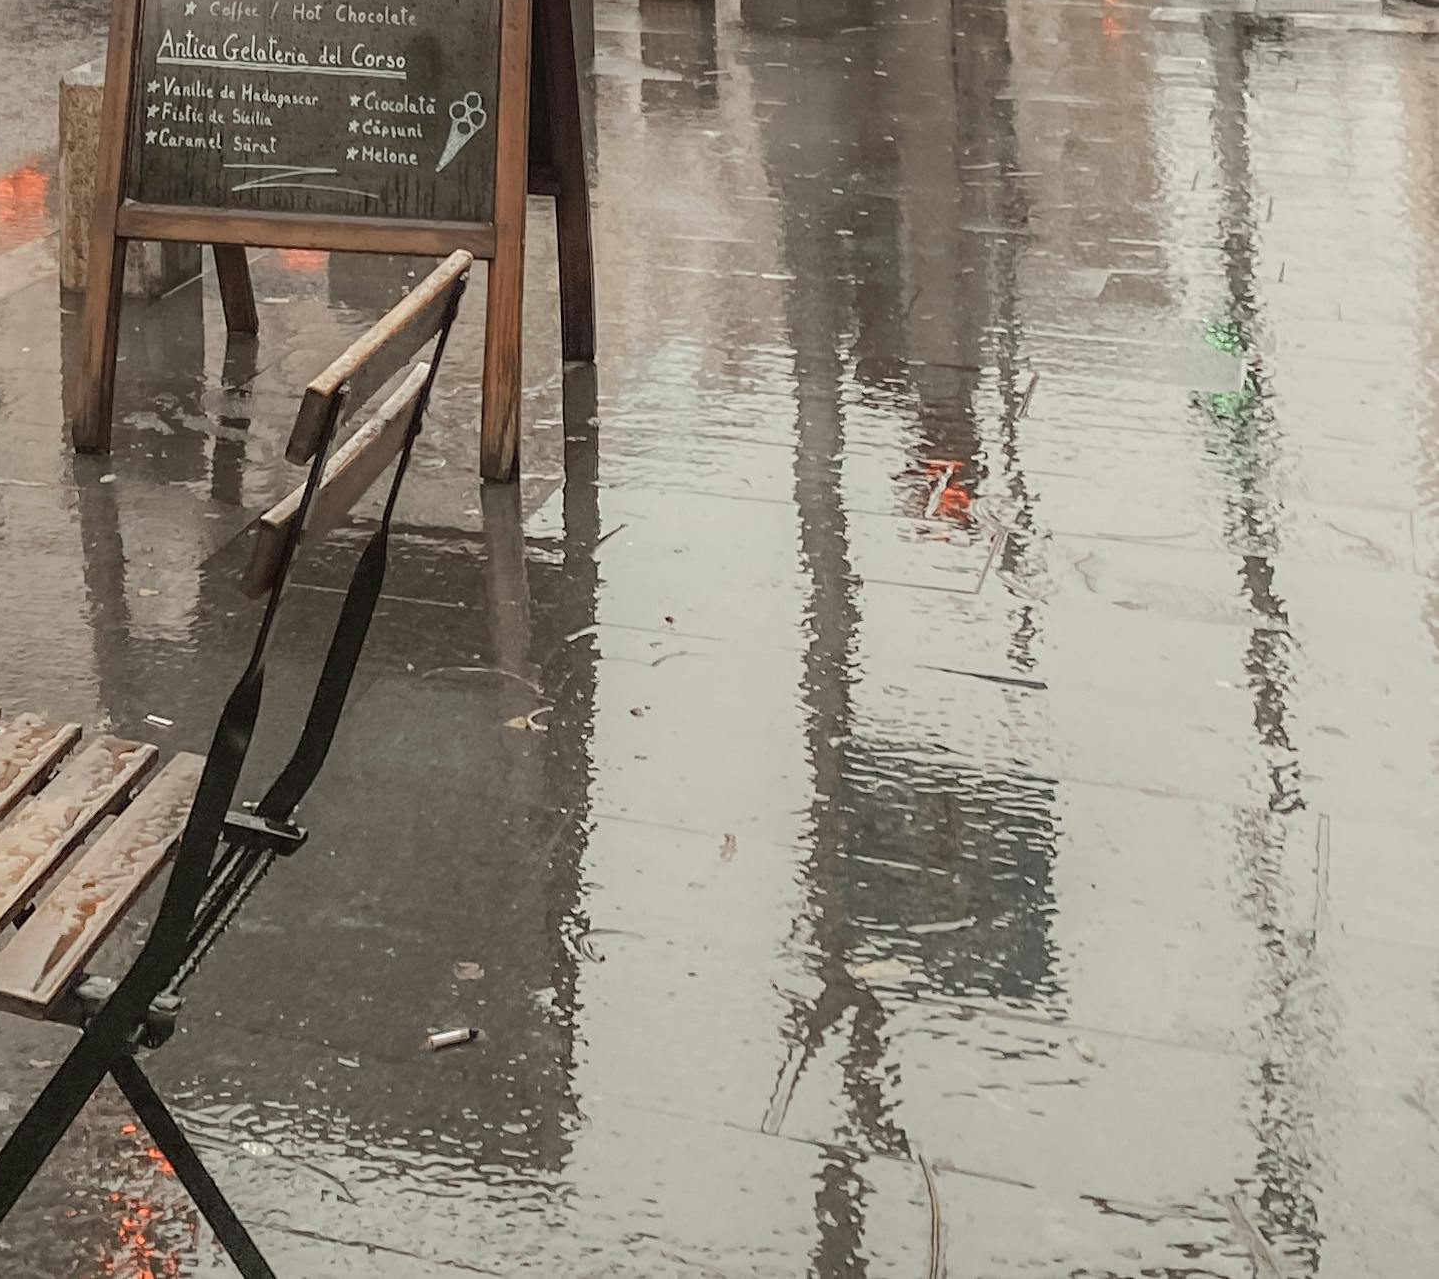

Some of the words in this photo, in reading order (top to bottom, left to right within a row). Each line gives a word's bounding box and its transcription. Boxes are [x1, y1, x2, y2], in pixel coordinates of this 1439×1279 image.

[209, 1, 260, 21] Coffee
[292, 3, 323, 21] Hot
[336, 4, 417, 27] Chocolate
[156, 29, 219, 60] Antica
[223, 33, 309, 65] Gelateria
[318, 45, 342, 65] del
[351, 43, 406, 69] Corso
[163, 76, 214, 99] Vanilie
[219, 84, 236, 100] de
[242, 83, 319, 109] Madagascar
[364, 90, 436, 115] Ciocolată
[161, 102, 204, 123] Fistic
[209, 108, 225, 124] de
[232, 108, 273, 126] Sicilia
[159, 128, 222, 150] Caramel
[362, 145, 419, 165] Melone
